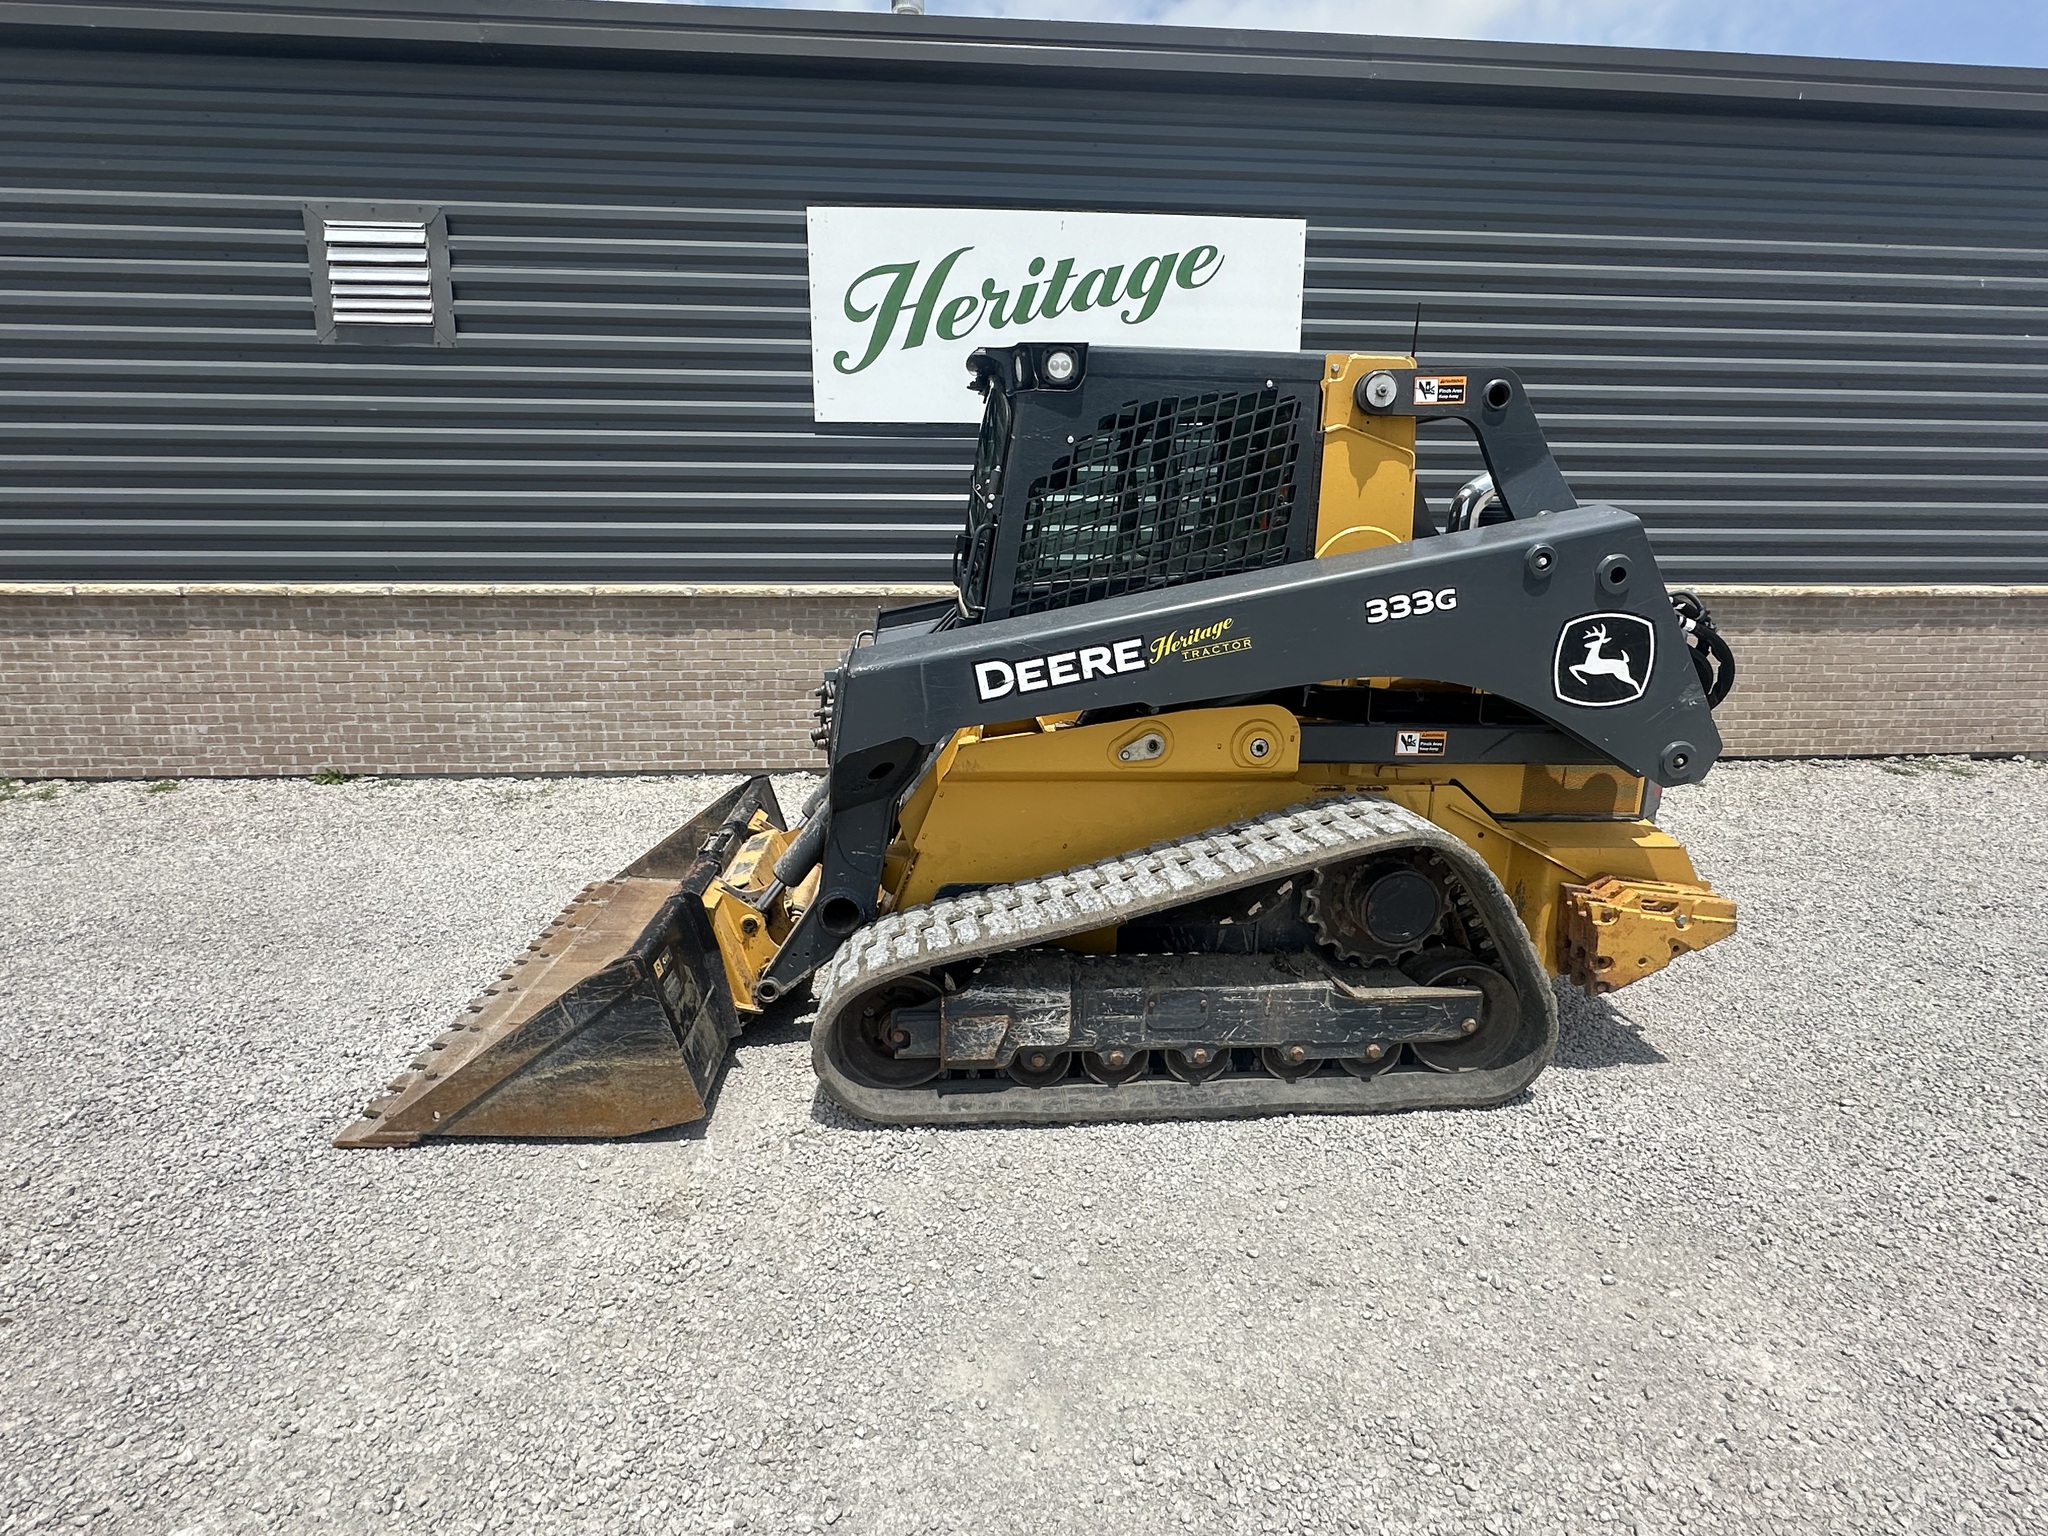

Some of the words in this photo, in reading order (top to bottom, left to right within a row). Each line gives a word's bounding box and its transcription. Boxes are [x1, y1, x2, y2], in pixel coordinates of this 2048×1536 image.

[833, 244, 1225, 374] Heritage
[1365, 588, 1457, 623] 333G
[1149, 616, 1234, 665] Heritage
[1181, 638, 1252, 660] TRACTOR
[974, 638, 1146, 701] DEERE
